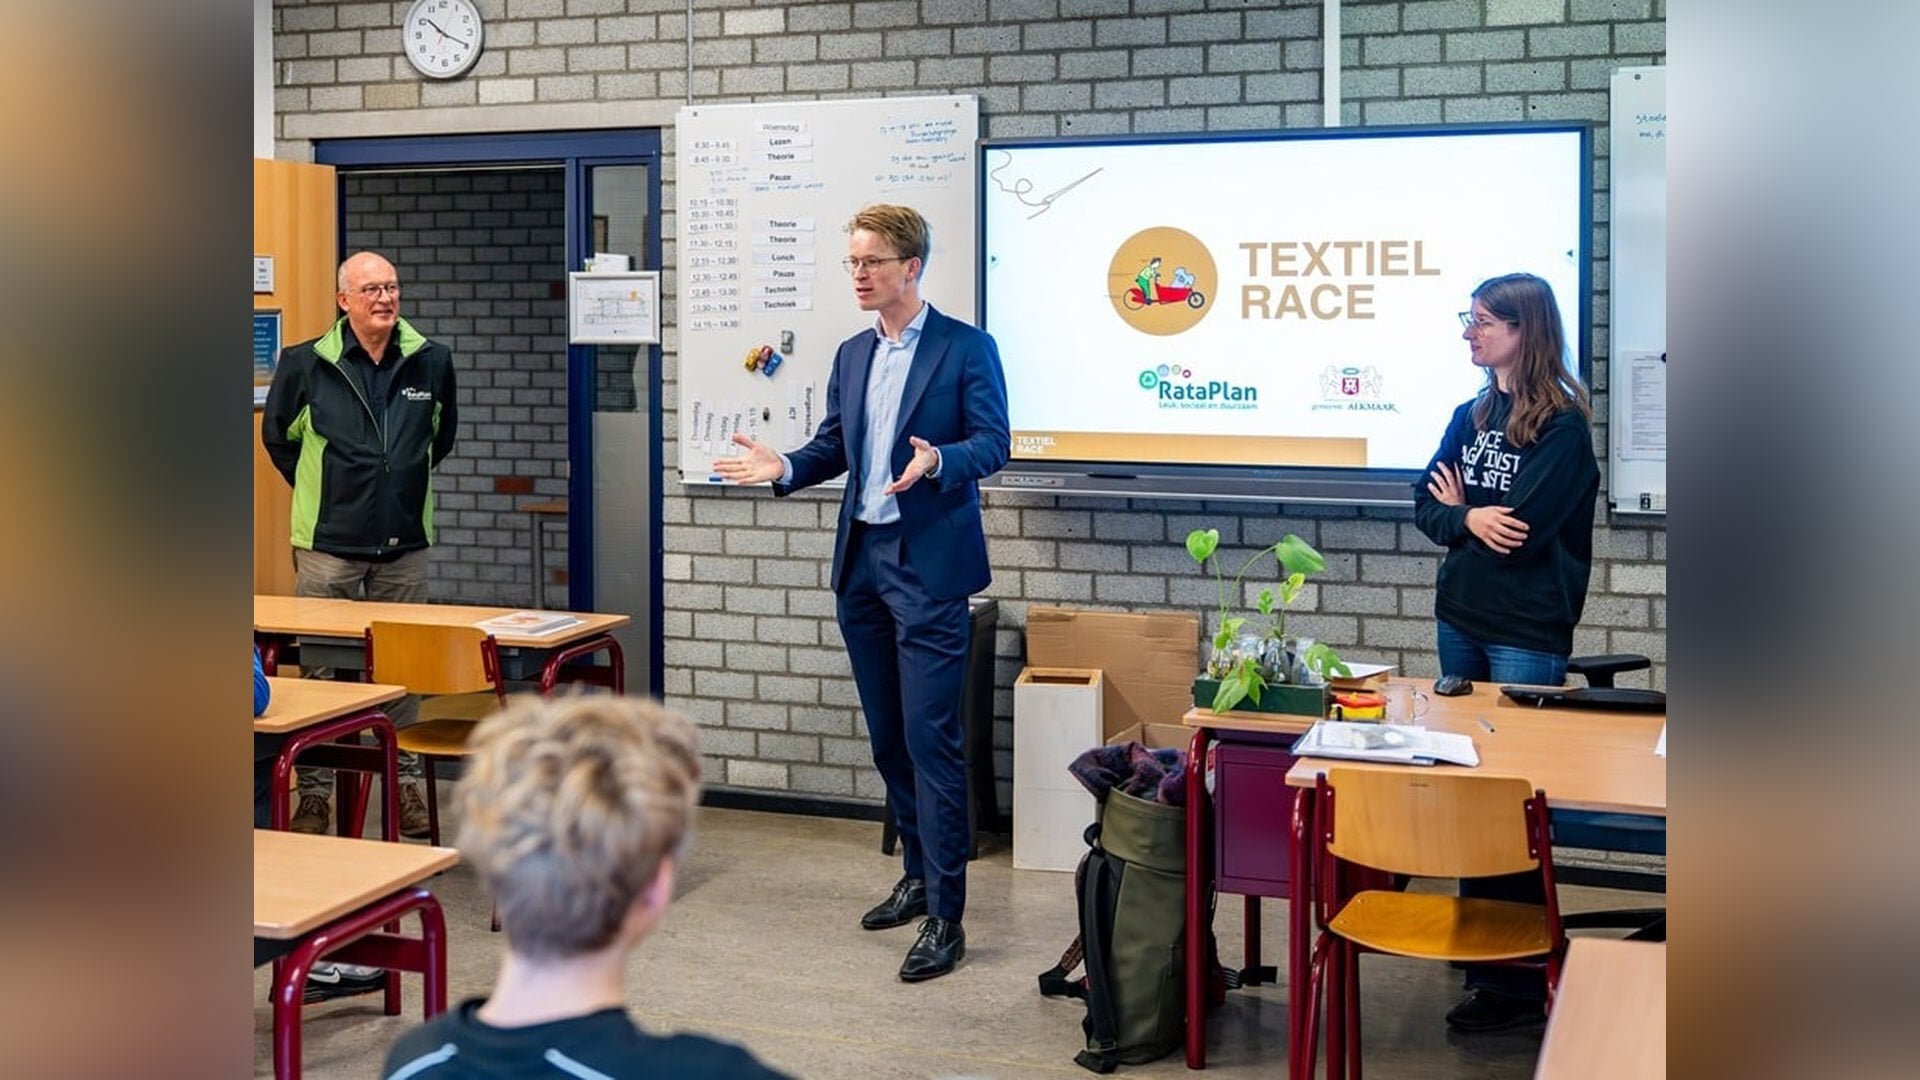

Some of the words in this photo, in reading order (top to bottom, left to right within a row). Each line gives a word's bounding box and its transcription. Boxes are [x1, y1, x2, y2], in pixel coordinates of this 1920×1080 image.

[428, 5, 435, 13] 11
[439, 1, 448, 9] 12
[418, 18, 427, 26] 10
[462, 15, 469, 24] 2
[415, 31, 422, 40] 9
[466, 28, 473, 37] 3
[430, 55, 436, 63] 7
[441, 58, 449, 67] 6
[453, 54, 460, 63] 5
[762, 122, 800, 133] Woensdag
[767, 153, 796, 161] Theorie
[769, 173, 792, 182] Pauze
[769, 220, 797, 228] Theorie
[769, 235, 797, 243] Theorie
[771, 253, 795, 262] Lunch
[1239, 240, 1441, 277] TEXTIEL
[772, 269, 796, 278] Pauze
[764, 285, 798, 294] Techniek
[764, 300, 798, 309] Techniek
[1241, 283, 1376, 320] RACE
[1159, 380, 1258, 402] RataPlan
[704, 412, 714, 441] Dinsdag
